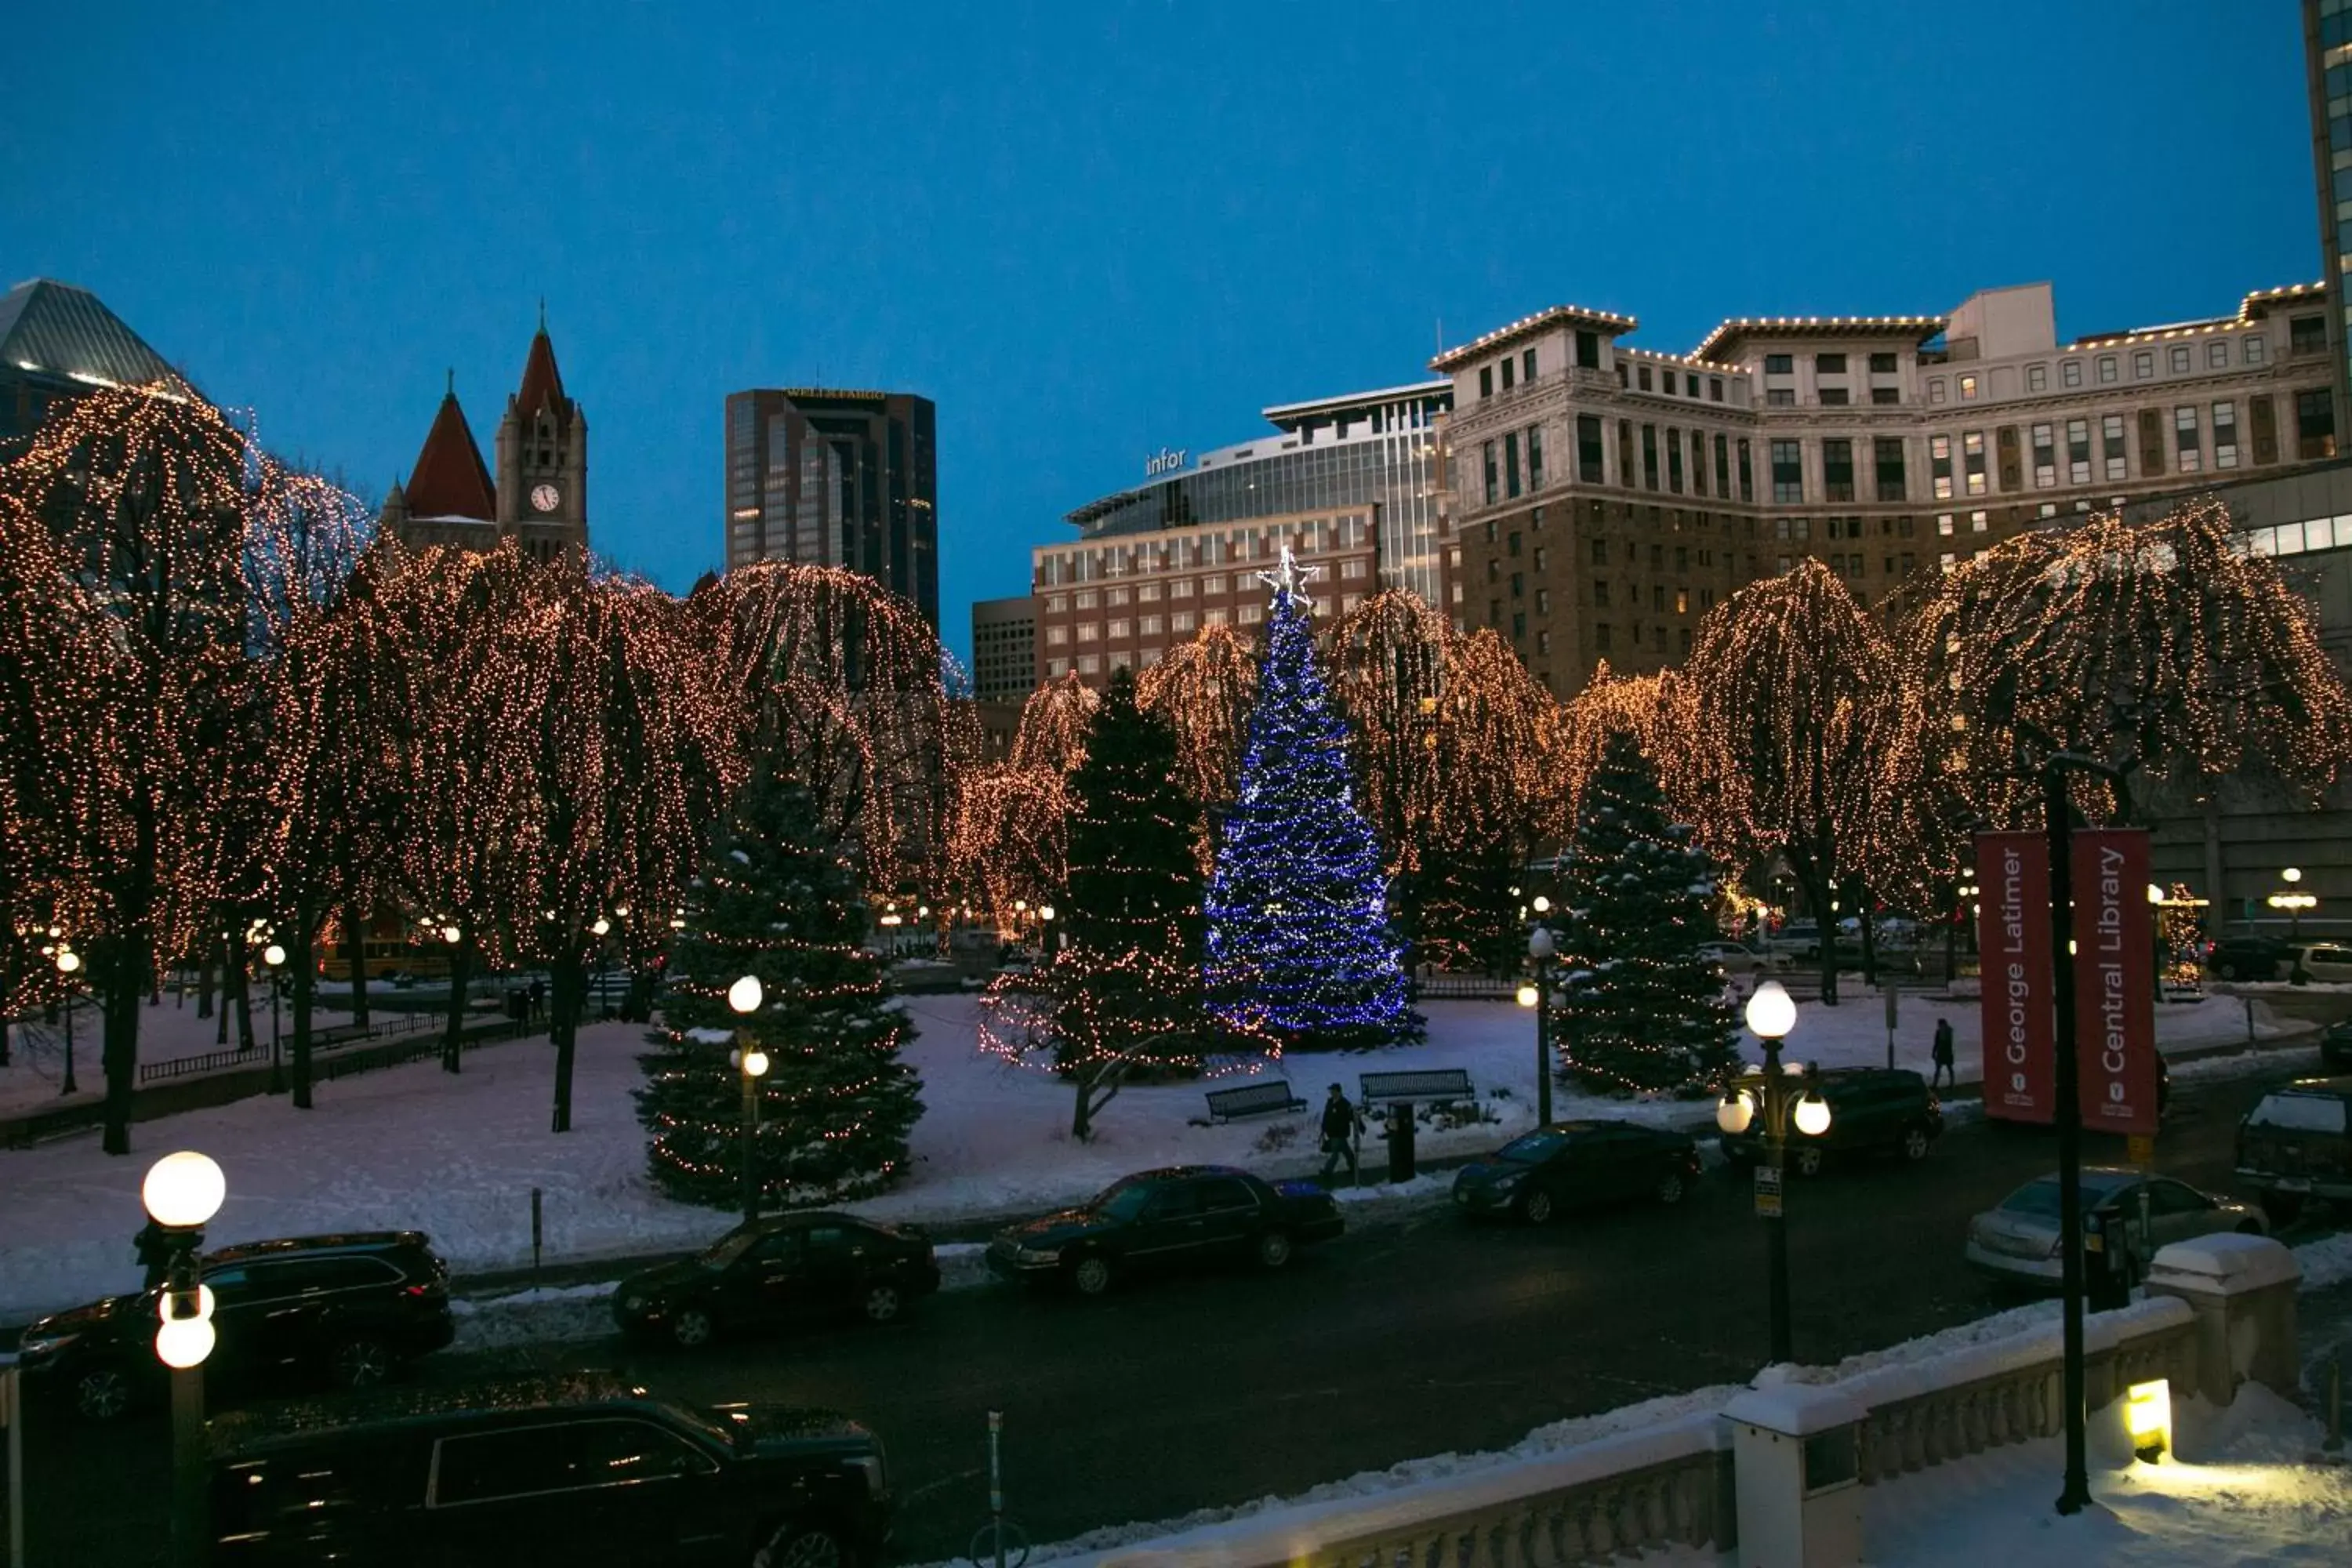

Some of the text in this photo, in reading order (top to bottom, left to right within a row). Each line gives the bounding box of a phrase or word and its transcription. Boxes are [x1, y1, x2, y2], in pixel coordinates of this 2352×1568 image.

[1147, 446, 1186, 476] infor
[2097, 846, 2125, 952] Library
[2002, 848, 2029, 1064] George Latimer
[2099, 963, 2125, 1073] Central
